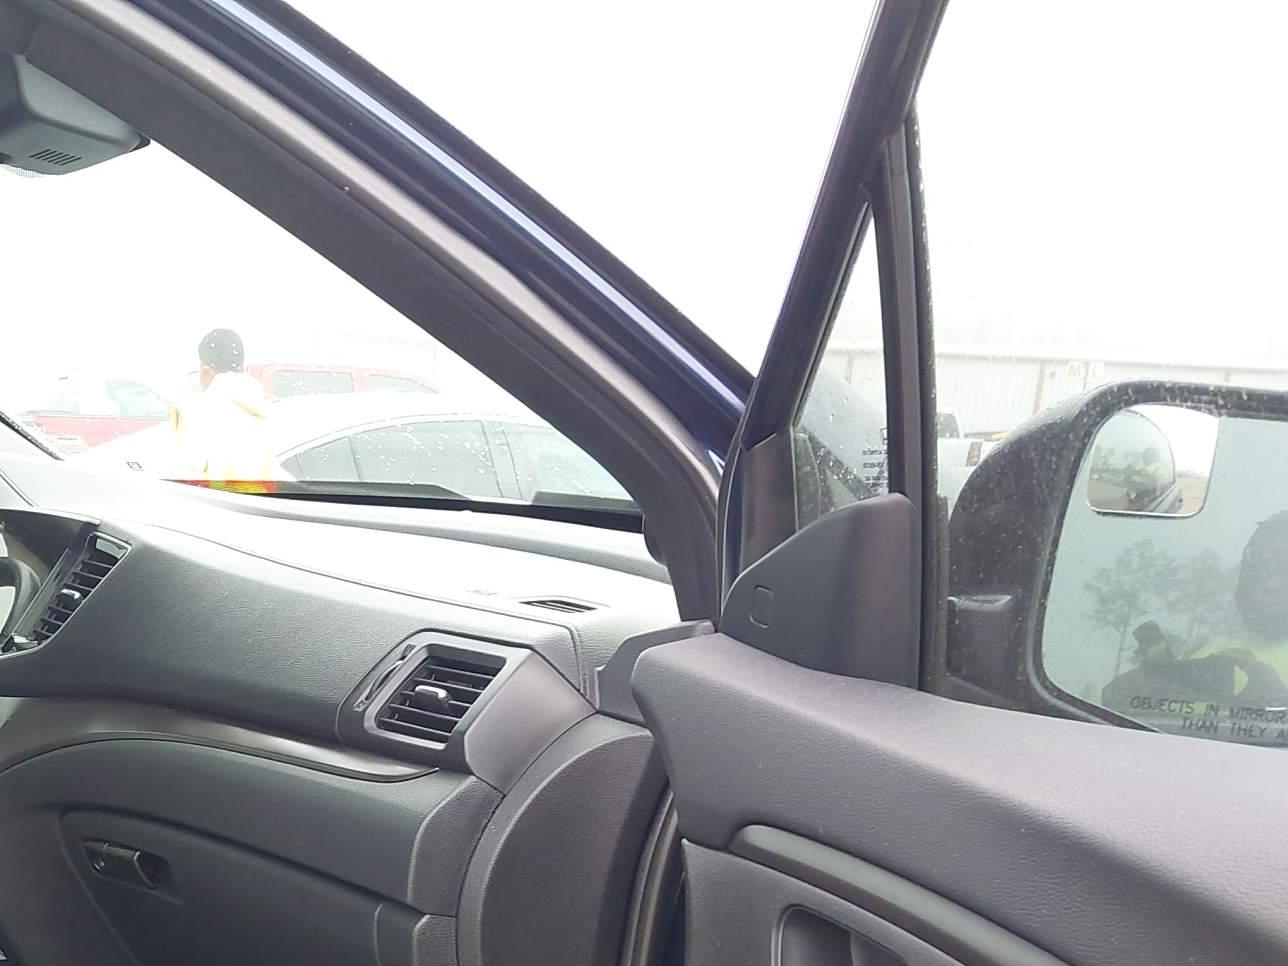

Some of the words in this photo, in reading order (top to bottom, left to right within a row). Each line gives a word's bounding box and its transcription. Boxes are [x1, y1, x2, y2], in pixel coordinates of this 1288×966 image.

[1129, 696, 1195, 714] OBJECTS
[1203, 703, 1220, 717] IN
[1229, 706, 1287, 724] MIRROR
[1181, 717, 1219, 734] THAN
[1230, 721, 1268, 738] THEY
